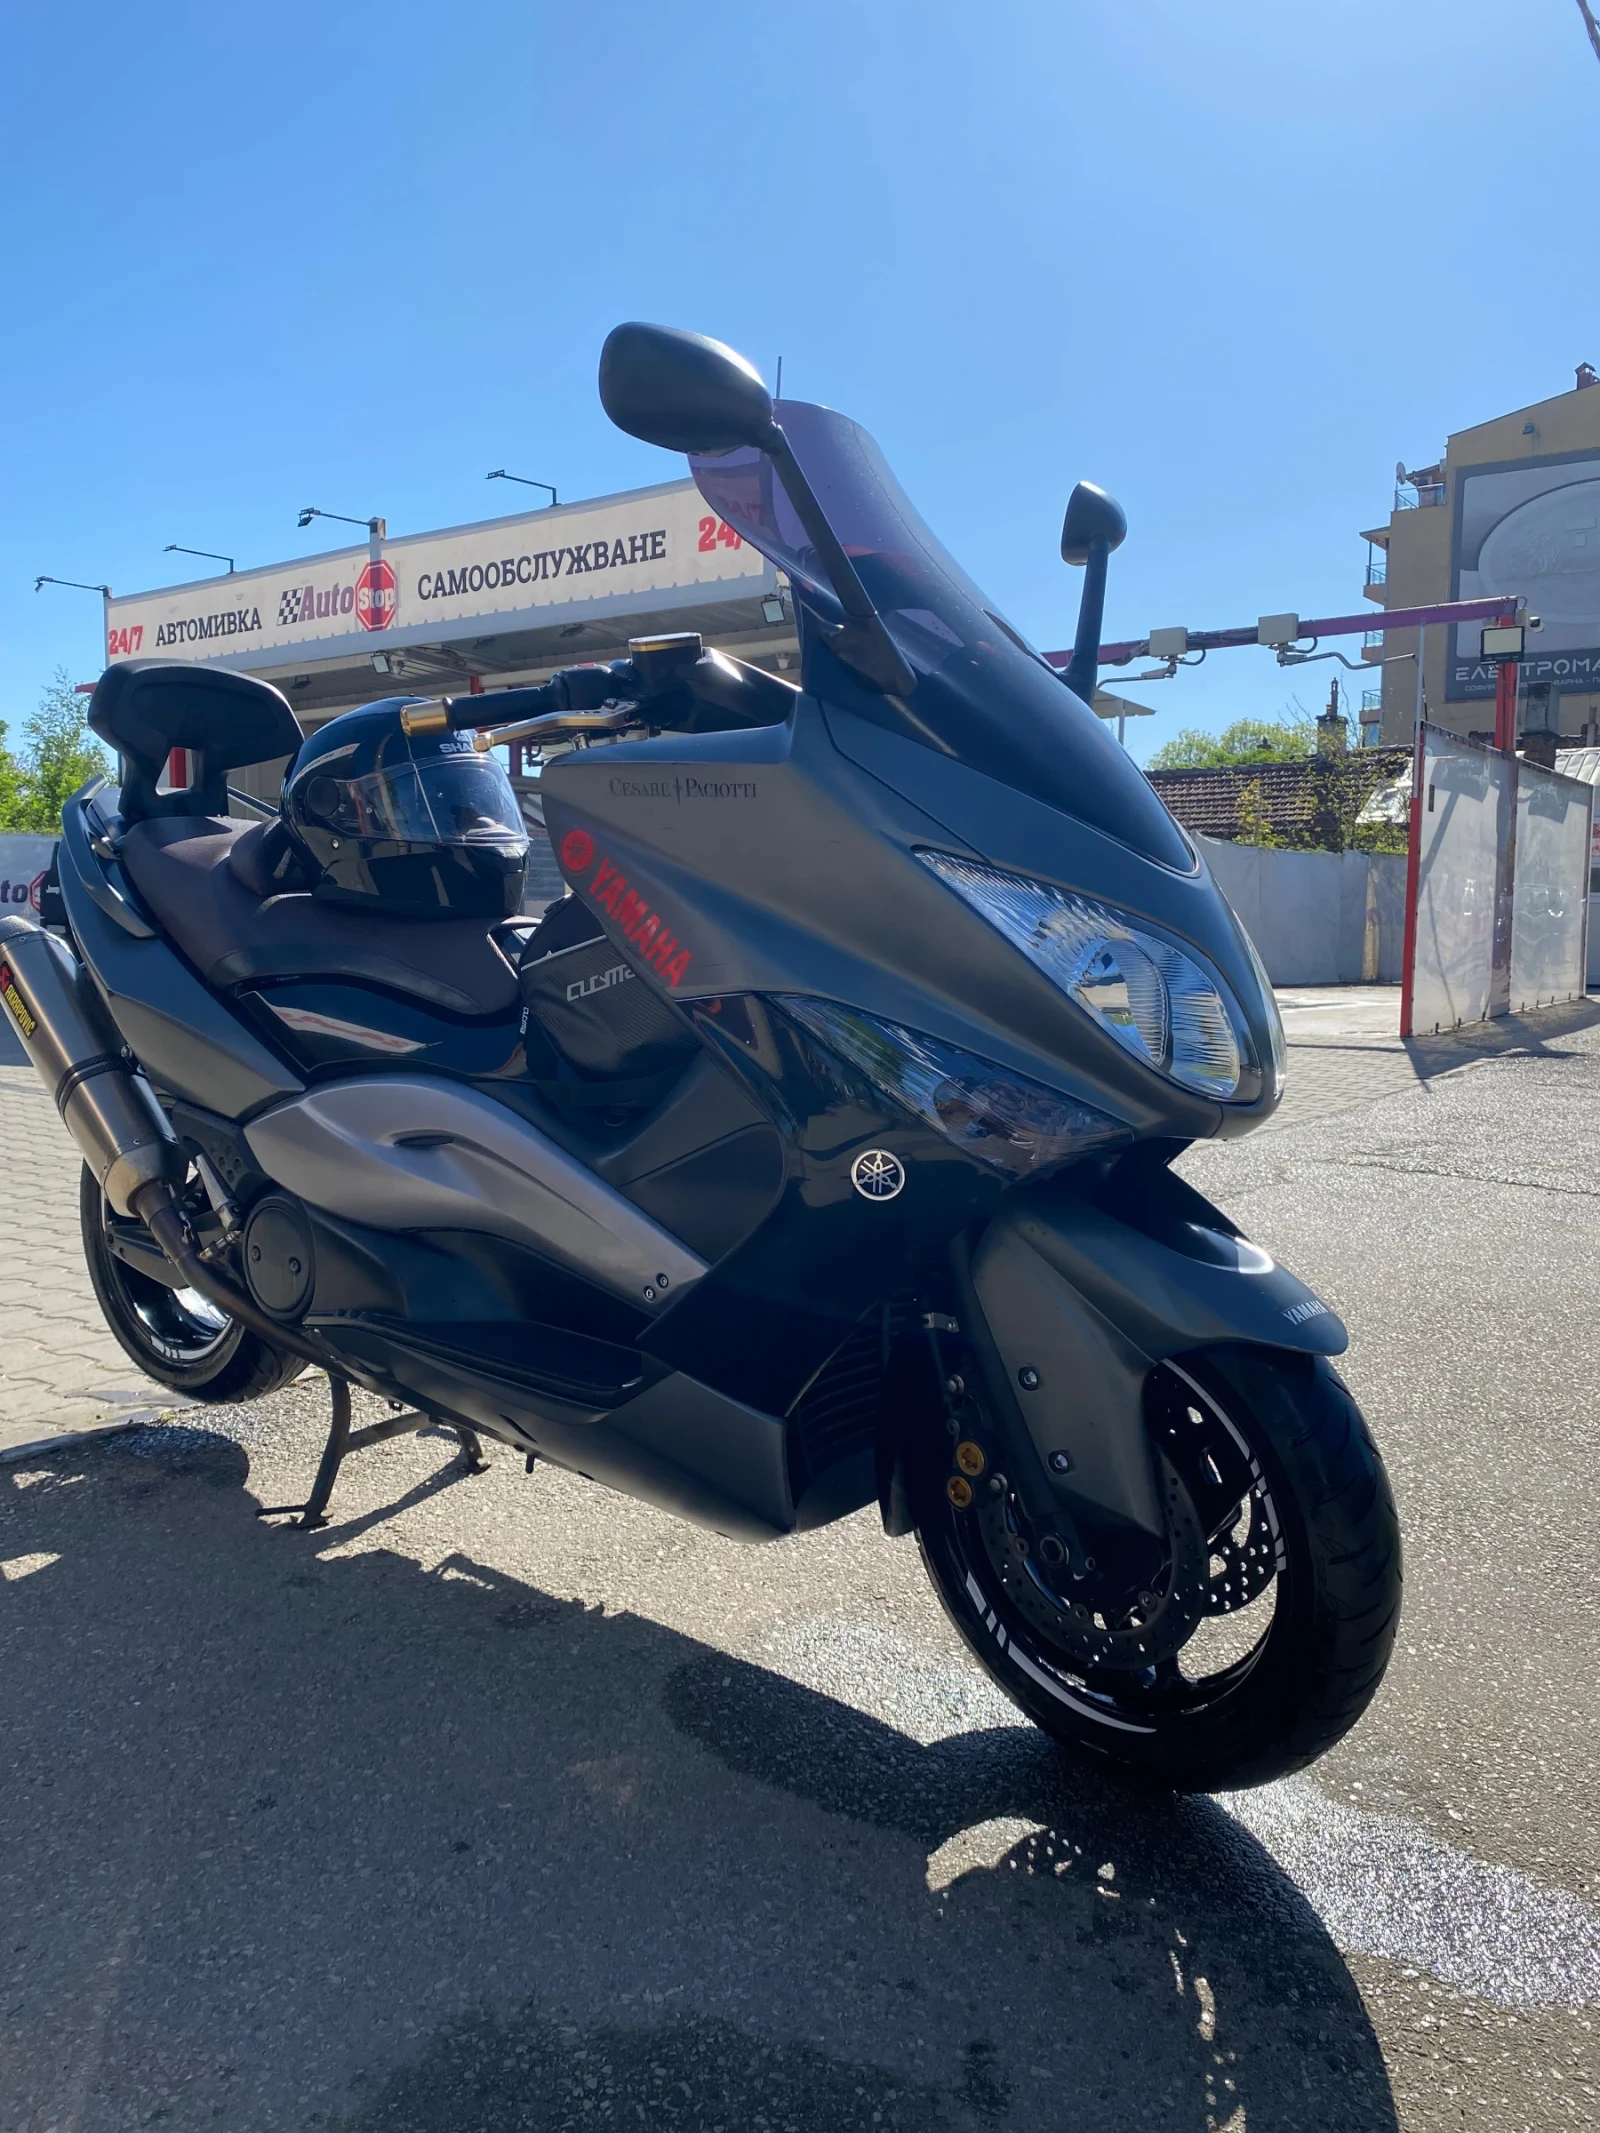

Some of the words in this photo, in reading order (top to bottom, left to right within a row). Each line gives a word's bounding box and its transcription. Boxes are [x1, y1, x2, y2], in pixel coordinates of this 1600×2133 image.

[418, 529, 667, 601] САМООБСЛУЖВАНЕ
[300, 582, 354, 622] Auto
[358, 585, 396, 611] Stop
[109, 625, 144, 655] 24/7
[155, 607, 263, 647] АВТОМИВКА
[439, 742, 473, 753] SHA
[0, 879, 29, 903] to
[588, 857, 693, 988] YAMAHA
[1282, 1299, 1329, 1326] YAMAHA
